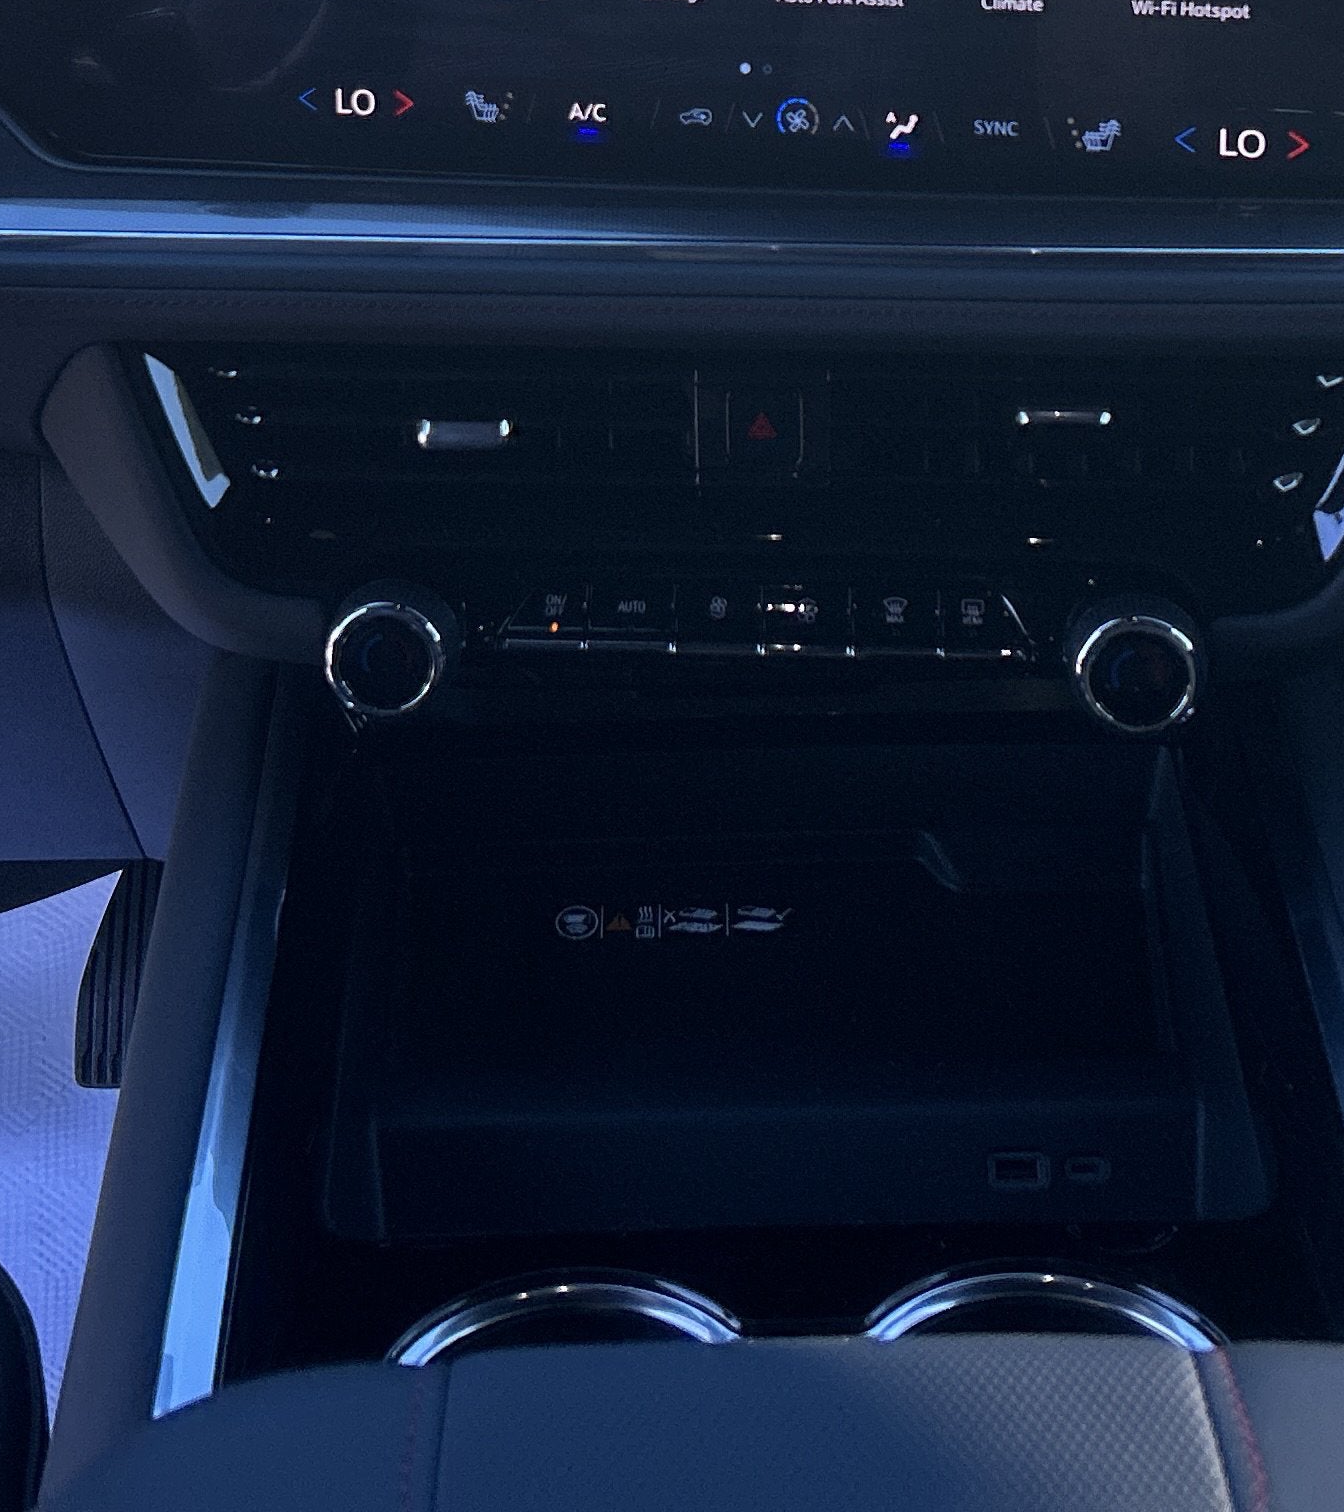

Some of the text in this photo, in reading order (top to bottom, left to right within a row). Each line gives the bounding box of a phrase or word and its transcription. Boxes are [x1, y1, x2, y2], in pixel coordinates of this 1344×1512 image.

[1131, 0, 1251, 22] Wi-Fi Hotspot
[335, 88, 376, 117] LO
[567, 102, 607, 123] A/C
[973, 119, 1019, 137] SYNC
[1217, 128, 1267, 158] LO
[545, 593, 568, 606] ON/
[617, 599, 647, 614] AUTO
[545, 605, 565, 617] OFF
